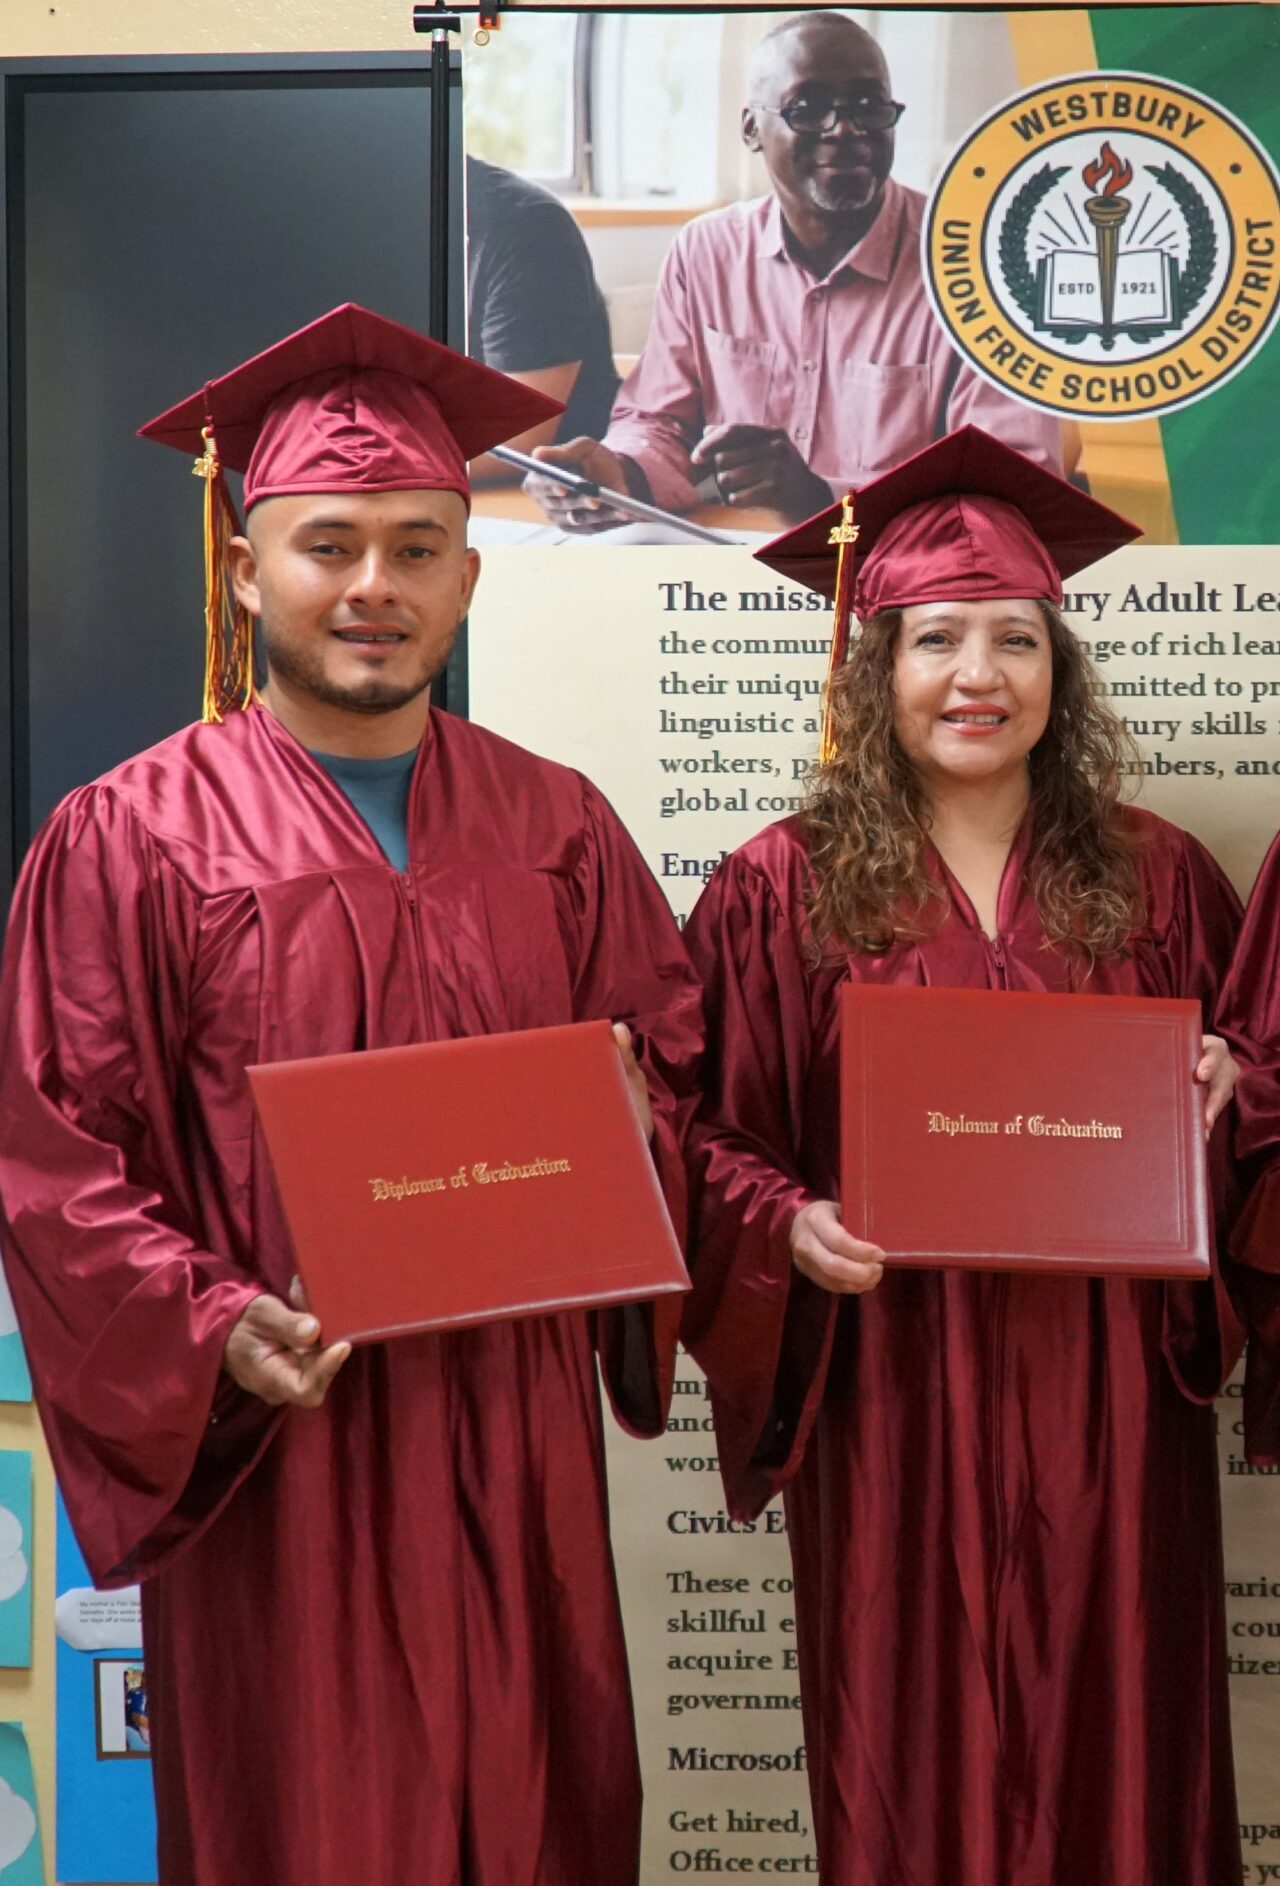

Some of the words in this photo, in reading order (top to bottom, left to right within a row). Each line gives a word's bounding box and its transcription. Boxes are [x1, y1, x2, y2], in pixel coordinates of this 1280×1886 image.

[1010, 90, 1207, 142] WESTBURY
[1058, 282, 1096, 296] ESTD
[1121, 281, 1158, 295] 1921
[940, 218, 987, 326] UNION
[974, 323, 1053, 392] FREE
[1060, 363, 1205, 404] SCHOOL
[1200, 216, 1276, 363] DISTRICT
[827, 524, 861, 545] 2025
[658, 581, 728, 612] The
[1118, 581, 1222, 613] Adult
[659, 630, 707, 655] the
[1131, 632, 1164, 656] of
[1168, 632, 1227, 656] rich
[659, 671, 730, 695] their
[1214, 677, 1243, 697] to
[659, 709, 795, 740] linguistic
[1191, 711, 1267, 735] skills
[659, 750, 782, 778] workers,
[660, 788, 748, 819] global
[927, 1111, 999, 1137] Diploma
[1004, 1115, 1024, 1135] of
[1027, 1115, 1124, 1139] Graduation
[368, 1175, 447, 1202] Diploma
[449, 1165, 470, 1190] of
[470, 1157, 572, 1186] Graduation
[666, 1570, 750, 1594] These
[667, 1609, 766, 1633] skillful
[667, 1649, 773, 1677] acquire
[669, 1810, 718, 1833] Get
[726, 1809, 809, 1838] hired,
[669, 1848, 753, 1873] Office
[758, 1854, 819, 1873] cert
